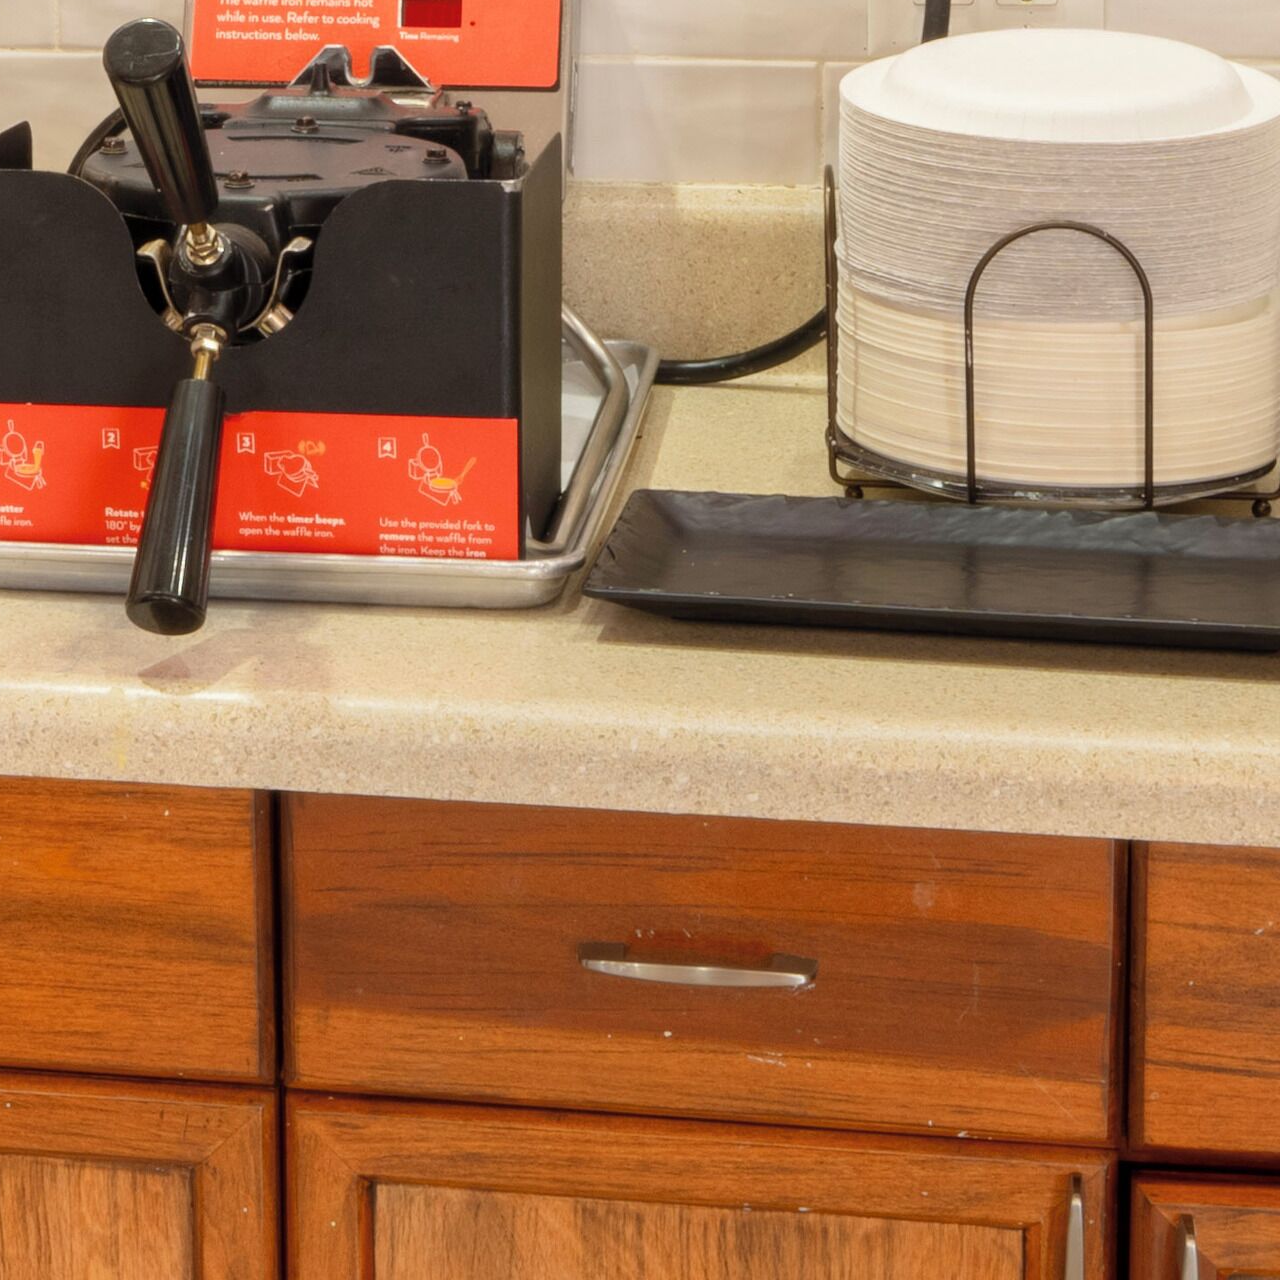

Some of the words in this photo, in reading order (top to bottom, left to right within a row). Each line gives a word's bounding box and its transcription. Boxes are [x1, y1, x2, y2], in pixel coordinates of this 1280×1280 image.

[216, 10, 245, 23] while
[248, 11, 259, 23] in
[262, 14, 284, 24] use.
[287, 11, 320, 24] Refer
[322, 14, 334, 25] to
[336, 12, 380, 28] cooking
[215, 28, 282, 41] instructions
[285, 28, 321, 41] below.
[107, 432, 116, 442] 2
[242, 437, 251, 447] 3
[105, 507, 139, 518] Rotate
[239, 511, 267, 522] When
[269, 512, 285, 523] the
[287, 513, 314, 524] timer
[129, 520, 141, 534] by
[379, 517, 399, 528] Use
[401, 518, 417, 529] the
[419, 519, 461, 531] provided
[463, 520, 482, 532] fork
[484, 522, 496, 532] to
[239, 527, 263, 537] open
[265, 525, 281, 536] the
[282, 526, 313, 537] waffle
[314, 527, 335, 538] iron.
[379, 532, 416, 542] remove
[418, 531, 434, 542] the
[435, 532, 466, 544] waffle
[468, 533, 493, 545] from
[105, 534, 120, 543] set
[380, 543, 395, 554] the
[398, 545, 418, 555] iron.
[420, 546, 446, 558] Keep
[448, 546, 464, 557] the
[466, 547, 487, 558] iron
